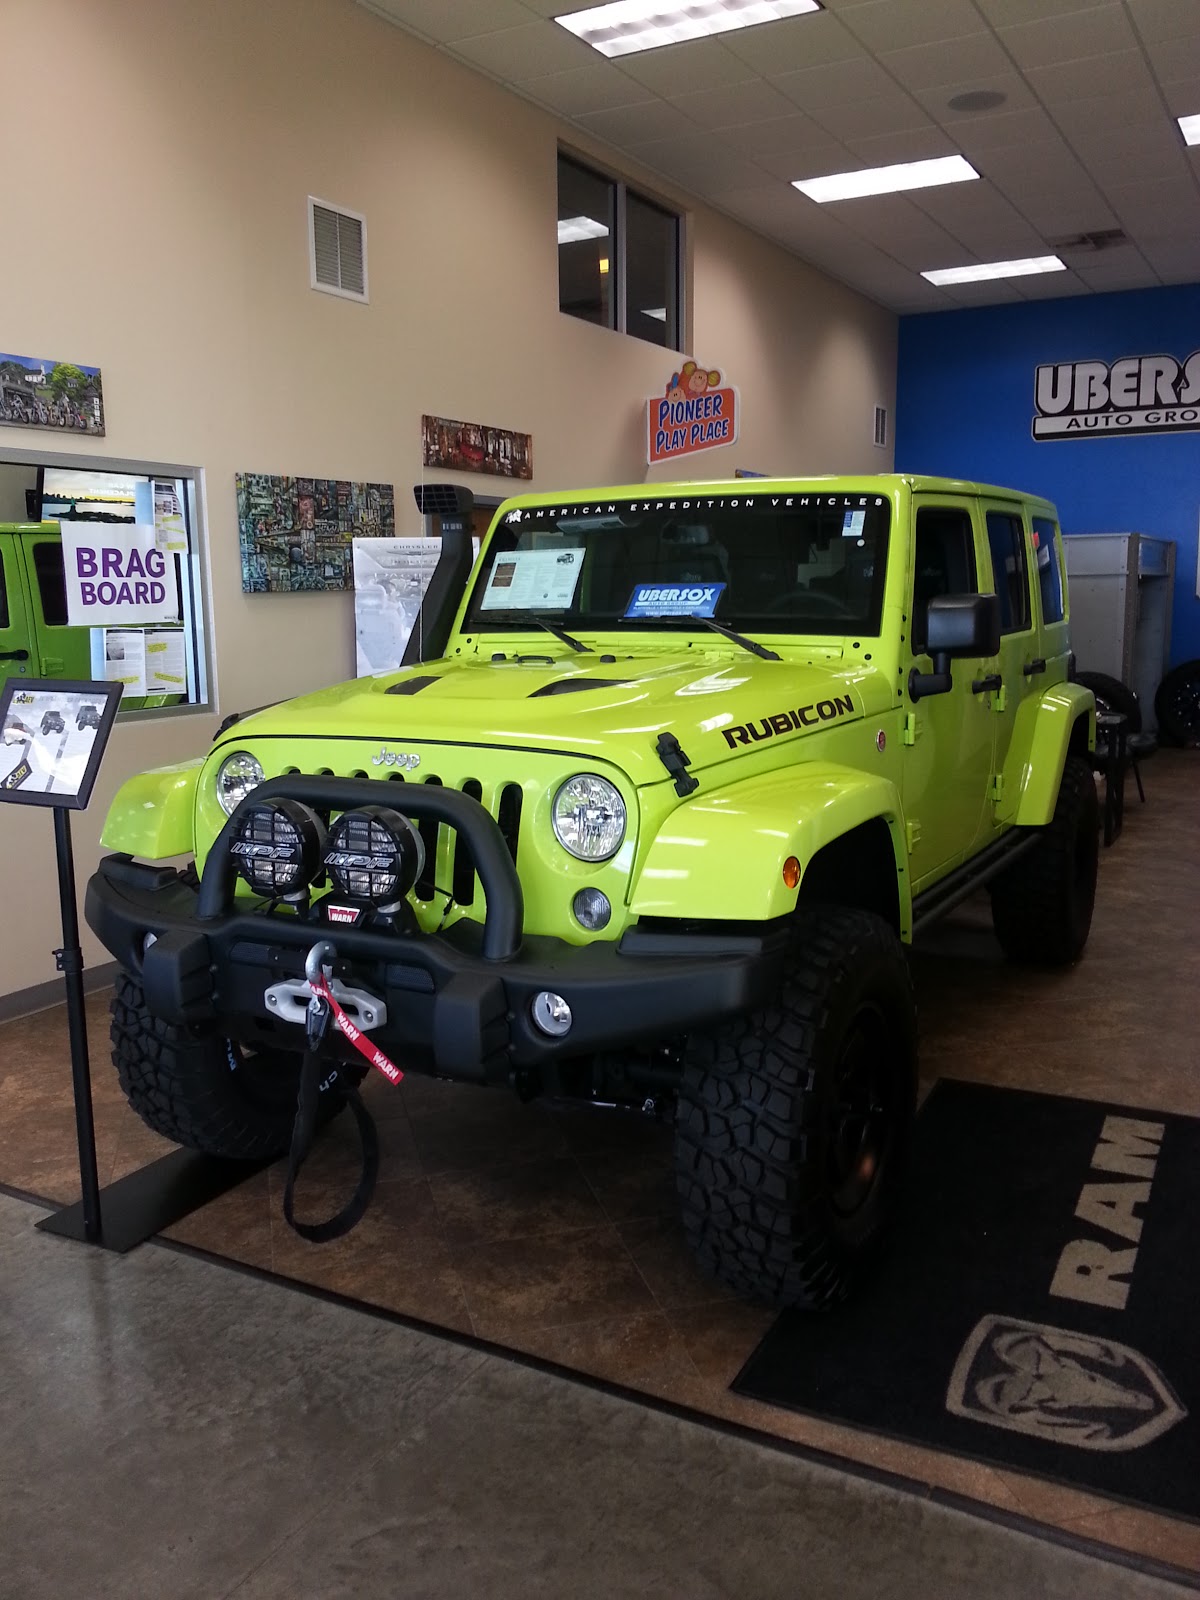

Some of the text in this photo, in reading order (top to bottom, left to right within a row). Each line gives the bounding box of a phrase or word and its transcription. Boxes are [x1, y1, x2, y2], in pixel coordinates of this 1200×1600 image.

[659, 394, 722, 428] PIONEER
[1066, 413, 1133, 429] AUTO
[656, 418, 729, 453] PLAY PLACE
[524, 498, 883, 520] AMERICAN EXPEDITION VEHICLES
[76, 547, 166, 578] BRAG
[80, 582, 166, 606] BOARD
[638, 588, 716, 601] UBERSOX
[721, 694, 855, 749] RUBICON
[371, 747, 420, 771] Jeep
[331, 912, 353, 923] WARN
[337, 1011, 361, 1042] WARN
[372, 1051, 400, 1080] WARN
[1049, 1115, 1165, 1310] RAM
